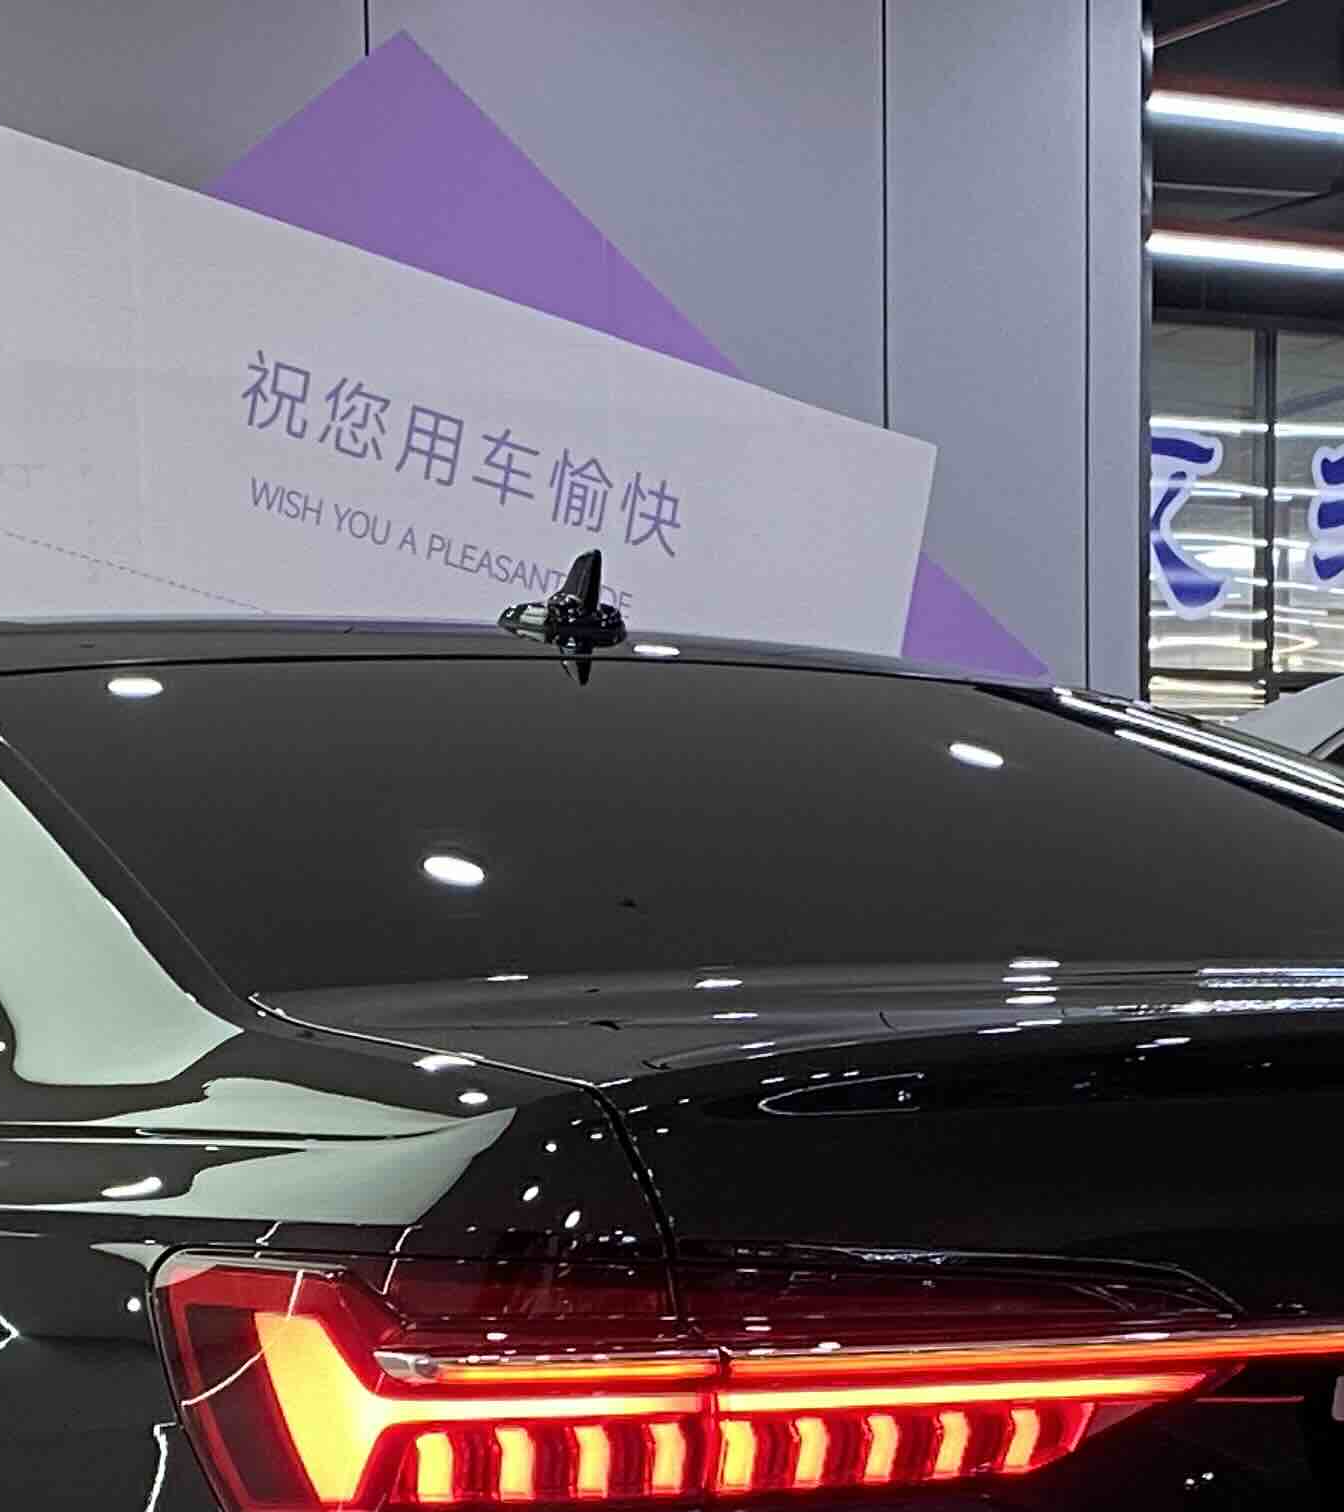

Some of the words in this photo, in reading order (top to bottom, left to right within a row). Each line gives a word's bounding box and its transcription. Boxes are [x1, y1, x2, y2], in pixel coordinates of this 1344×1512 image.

[240, 350, 681, 558] 祝您用车愉快
[251, 476, 324, 526] WISH
[333, 503, 392, 546] YOU
[398, 526, 417, 556] A
[426, 534, 566, 594] PLEASANT
